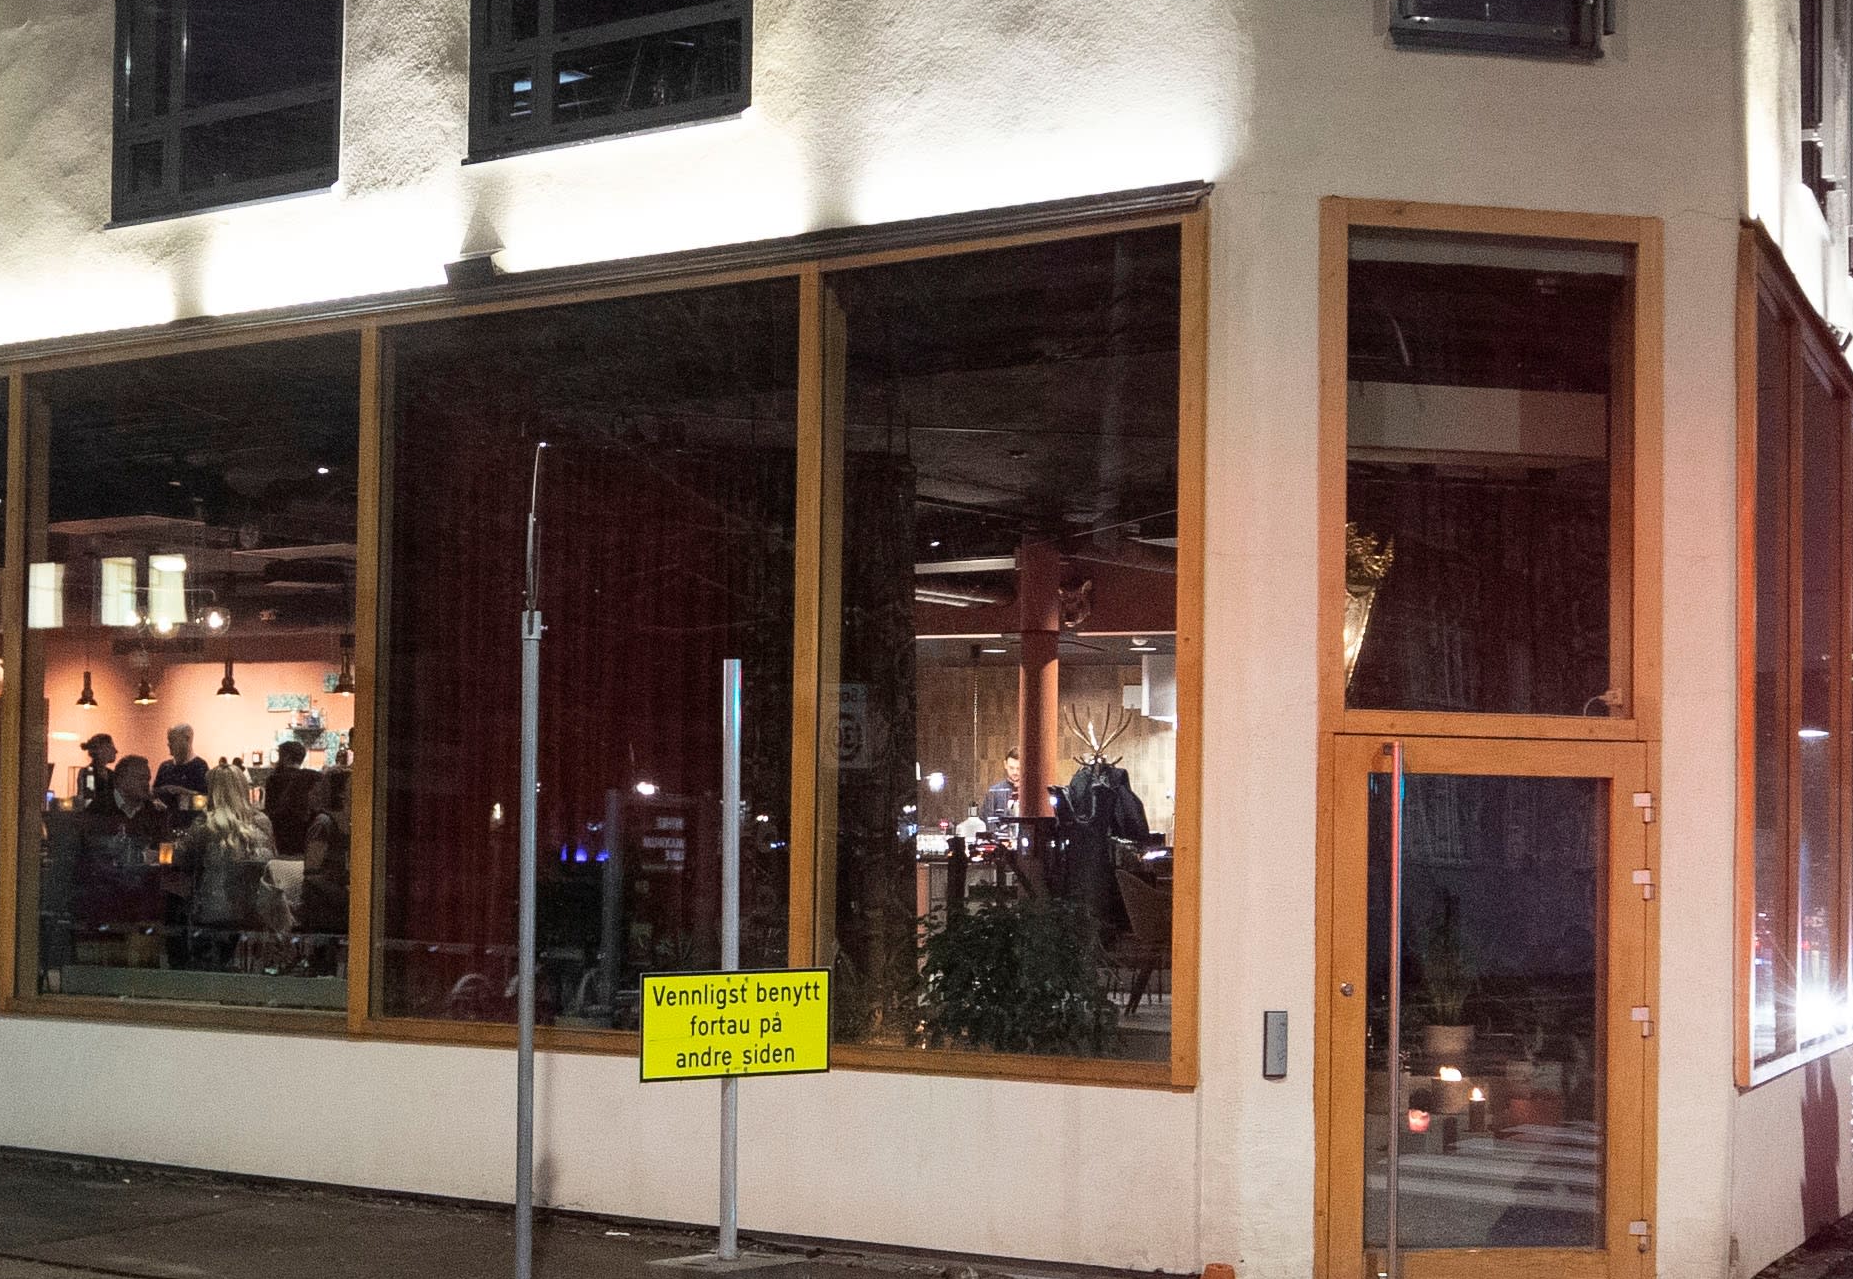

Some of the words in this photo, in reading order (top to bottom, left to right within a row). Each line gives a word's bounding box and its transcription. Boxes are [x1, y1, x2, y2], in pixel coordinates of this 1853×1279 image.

[652, 982, 748, 1010] Vennligst
[756, 981, 821, 1006] benytt
[690, 1014, 750, 1037] fortau
[760, 1011, 782, 1038] på
[675, 1046, 732, 1069] andre
[742, 1044, 795, 1065] siden
